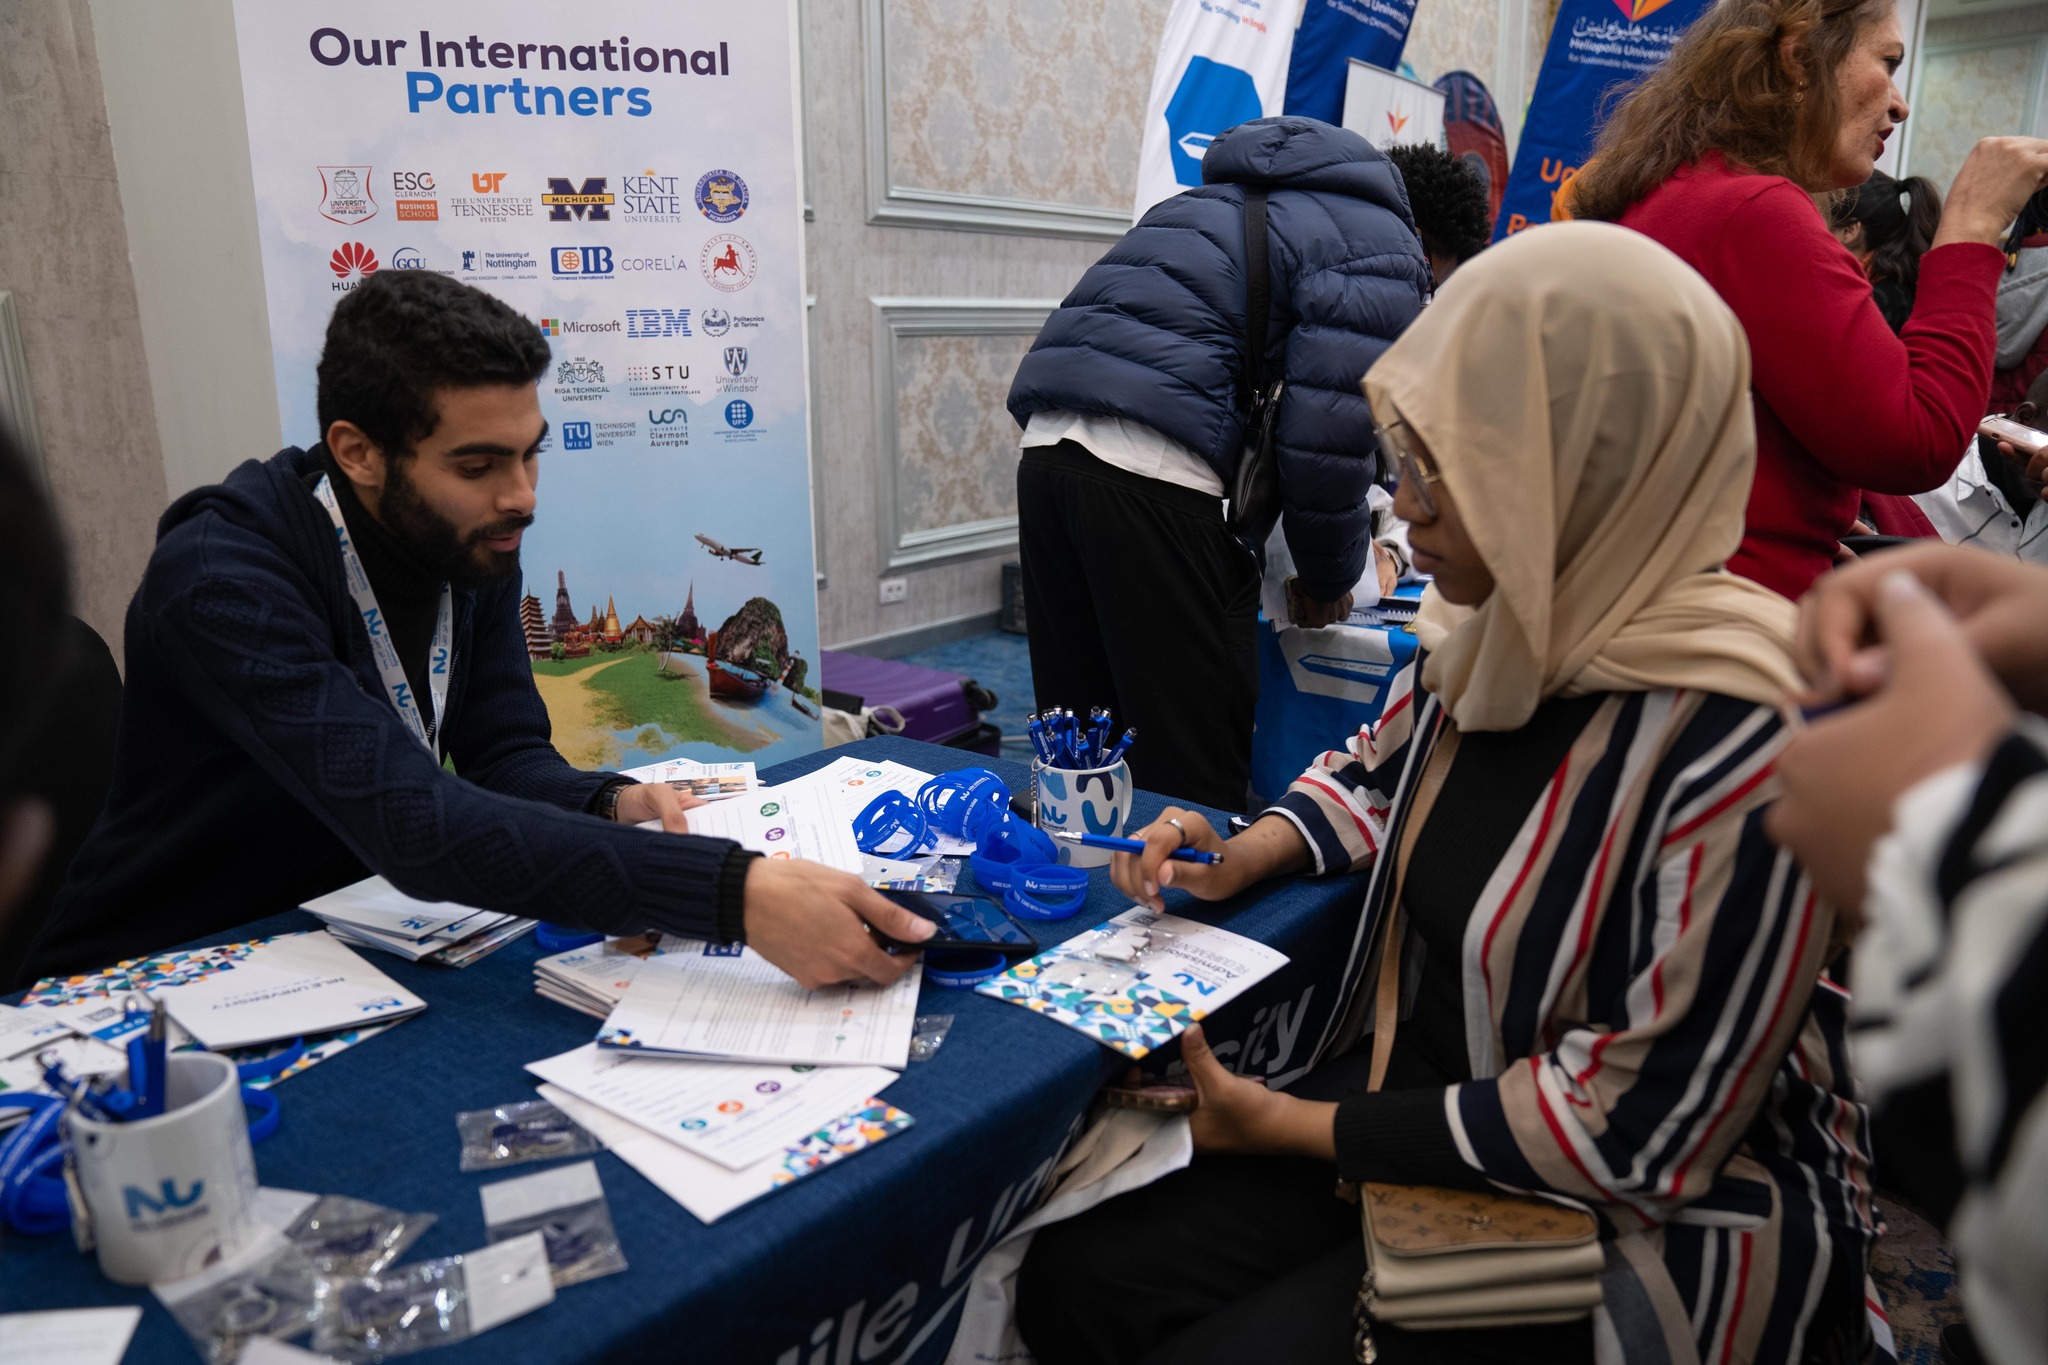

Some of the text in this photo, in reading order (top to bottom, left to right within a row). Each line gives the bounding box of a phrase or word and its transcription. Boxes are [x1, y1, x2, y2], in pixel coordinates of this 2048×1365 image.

[309, 27, 729, 76] Our International
[406, 71, 652, 117] Partners
[393, 172, 436, 191] ESC
[622, 176, 679, 195] KENT
[552, 196, 605, 204] MICHIGAN
[623, 194, 681, 214] STATE
[400, 210, 436, 218] SCHOOL
[451, 204, 534, 217] TENNESSEE
[624, 215, 682, 223] UNIVERSITY
[496, 252, 523, 260] University
[397, 257, 427, 270] GCU
[485, 258, 537, 270] Nottingham
[563, 319, 621, 333] Microsoft
[626, 309, 692, 338] IBM
[652, 365, 690, 380] STU
[715, 375, 759, 385] University
[723, 384, 759, 393] Windsor
[562, 394, 603, 402] UNIVERSITY
[564, 424, 590, 440] TU
[595, 422, 637, 430] TECHNISCHE
[595, 430, 637, 439] UNIVERSITÄT
[650, 432, 689, 440] Clermont
[566, 440, 590, 448] WIEN
[650, 440, 689, 448] Auvergne
[362, 607, 382, 636] NU
[387, 642, 399, 669] University
[432, 647, 448, 675] NU
[392, 682, 412, 708] NU
[1041, 802, 1068, 825] NU
[1025, 879, 1038, 889] NU
[1173, 972, 1218, 996] NU
[122, 1177, 206, 1221] NU
[776, 1281, 919, 1365] ile
